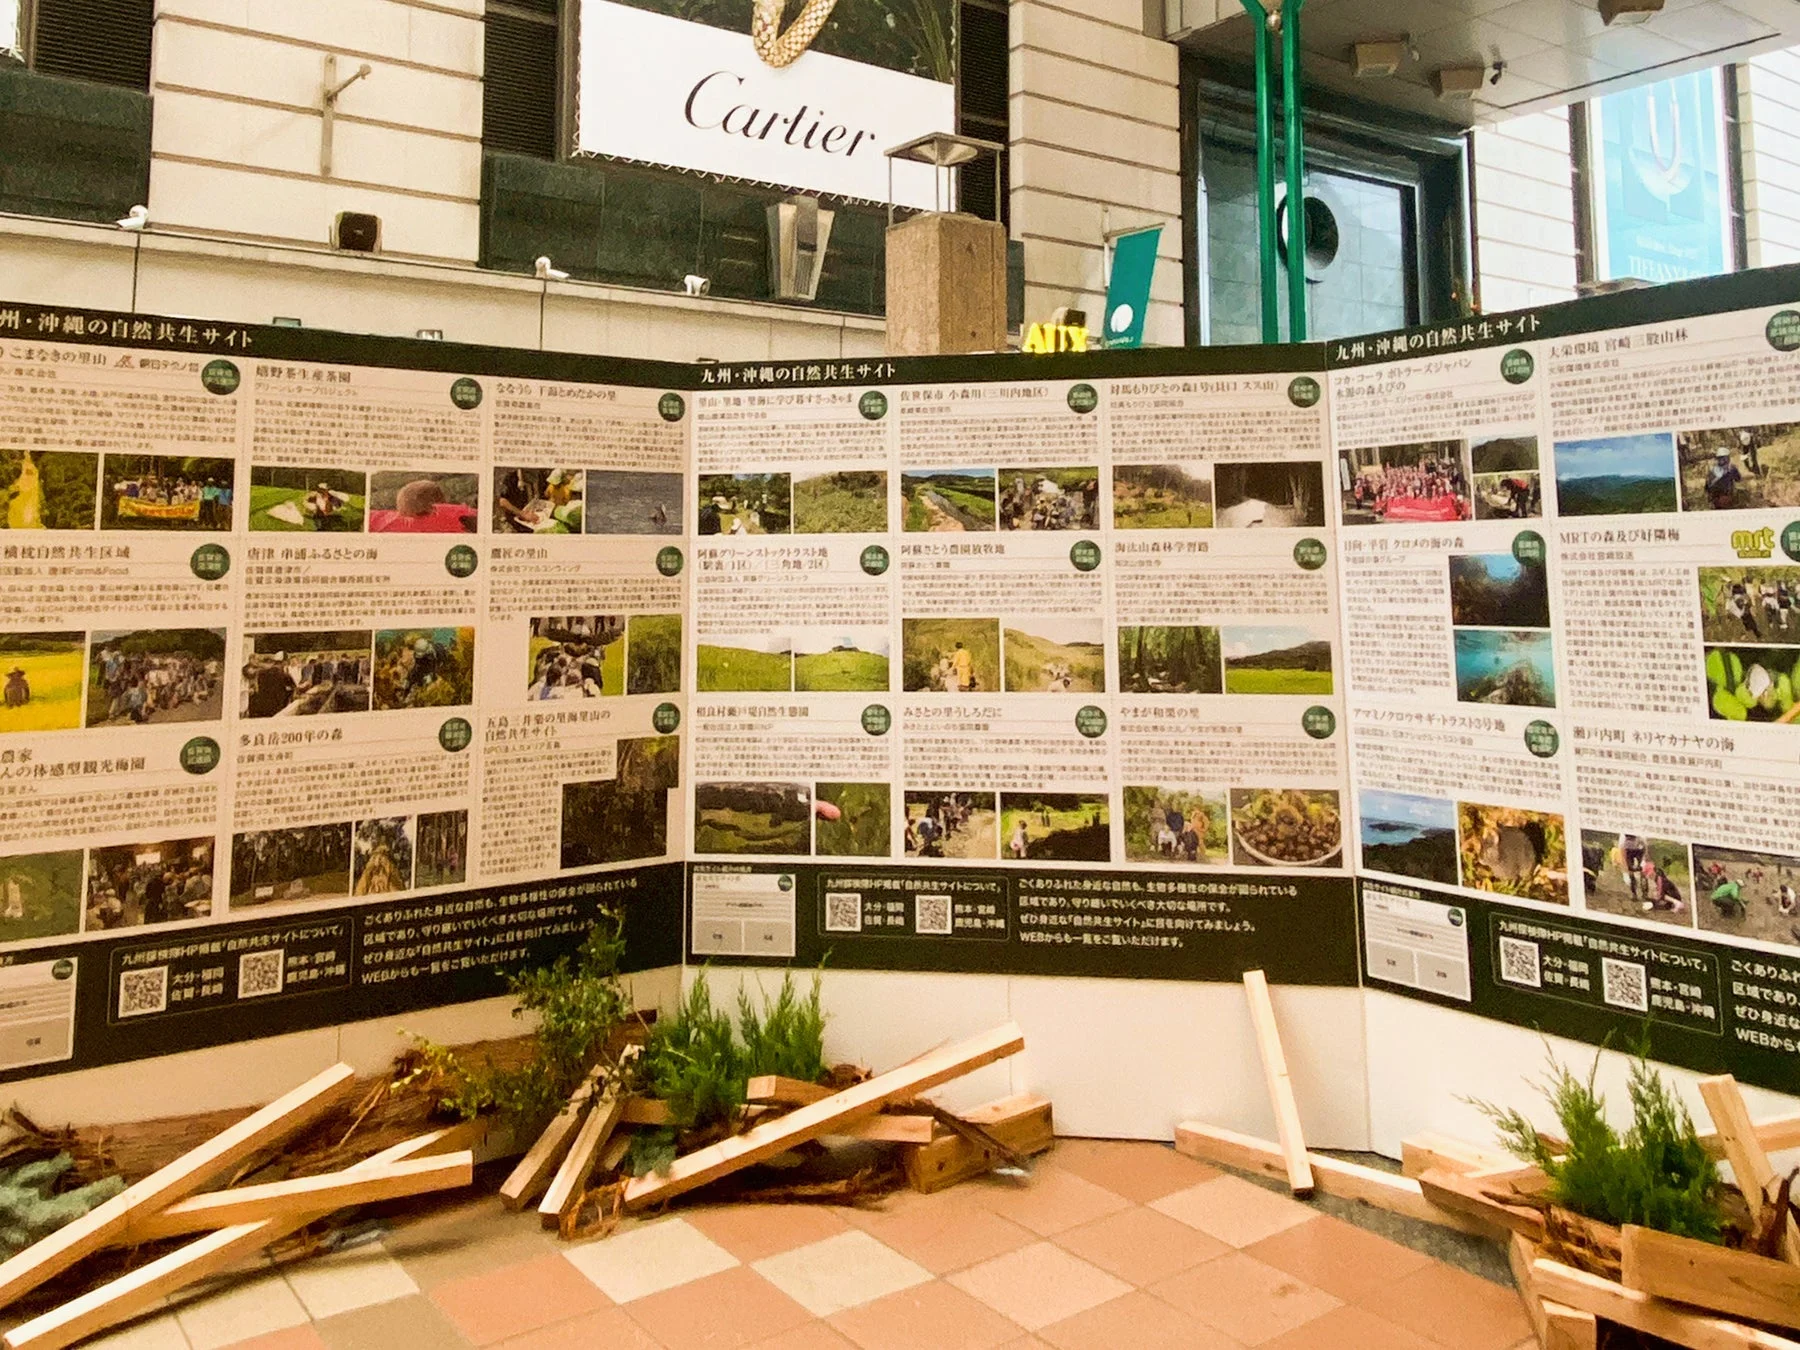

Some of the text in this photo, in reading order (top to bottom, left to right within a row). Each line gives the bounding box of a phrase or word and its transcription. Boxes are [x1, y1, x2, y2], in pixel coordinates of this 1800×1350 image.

[684, 70, 876, 157] Cartier
[0, 309, 253, 348] 州・沖縄の自然共生サイト
[1335, 314, 1541, 361] 九州・沖縄の自然共生サイト
[701, 363, 896, 384] 九州・沖縄の自然共生サイト
[1731, 526, 1775, 550] mrt
